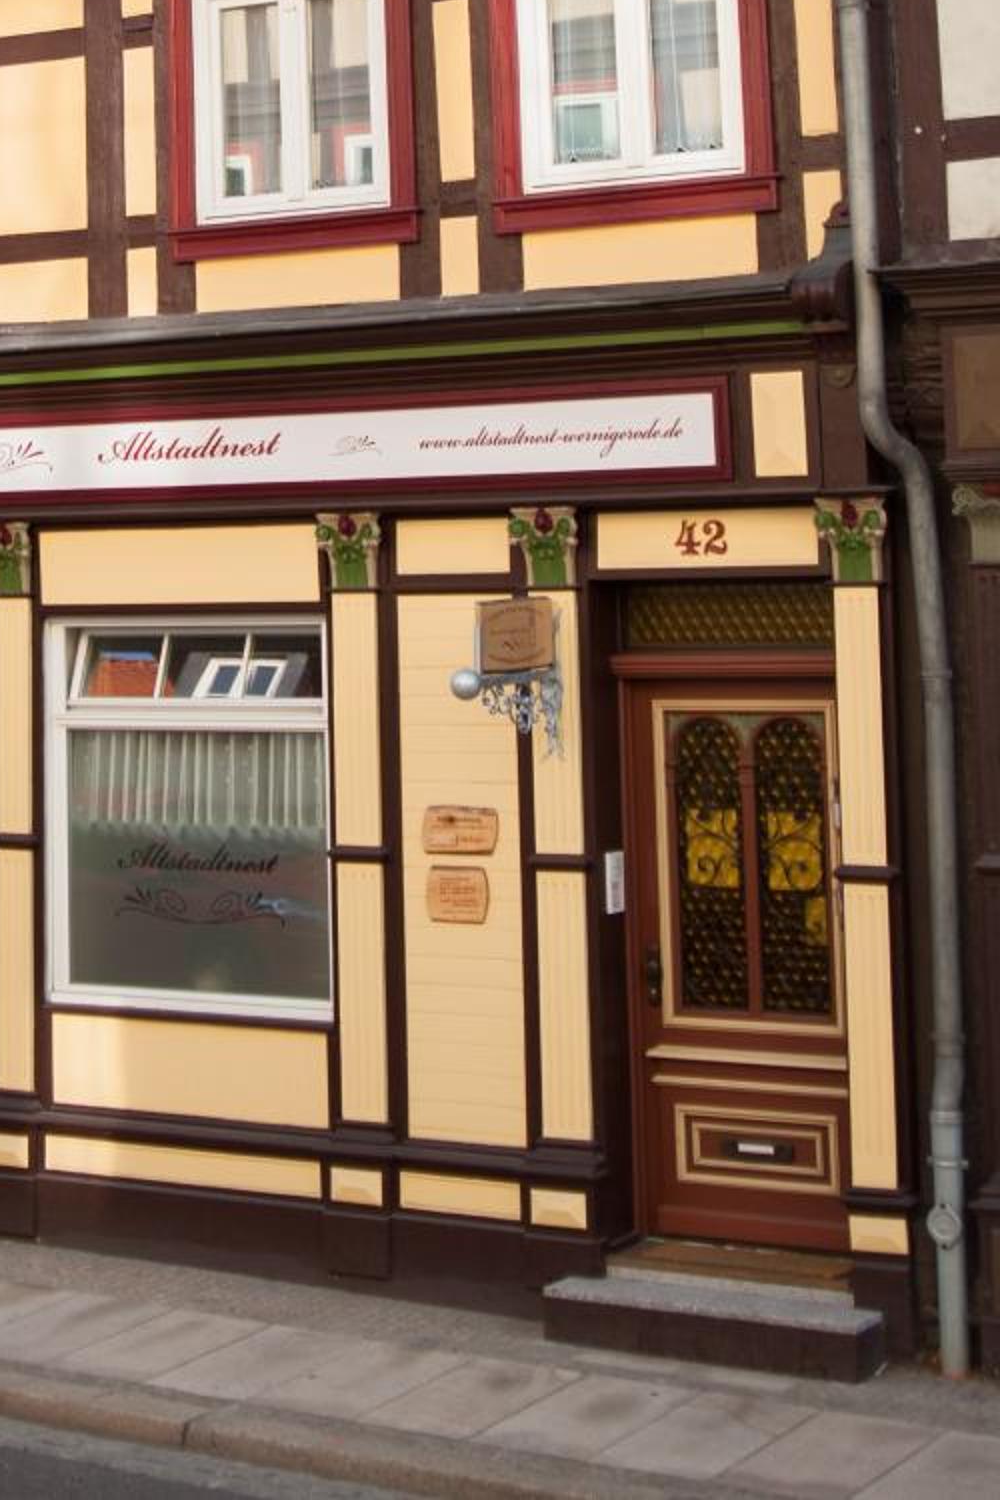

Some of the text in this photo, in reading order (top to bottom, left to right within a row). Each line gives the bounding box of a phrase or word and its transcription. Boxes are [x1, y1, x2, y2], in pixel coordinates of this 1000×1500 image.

[97, 427, 281, 464] Altstadtnest
[418, 417, 684, 458] www.altstadtnest-wernigerode.de
[674, 519, 729, 556] 42
[117, 842, 281, 874] Altstadtnest
